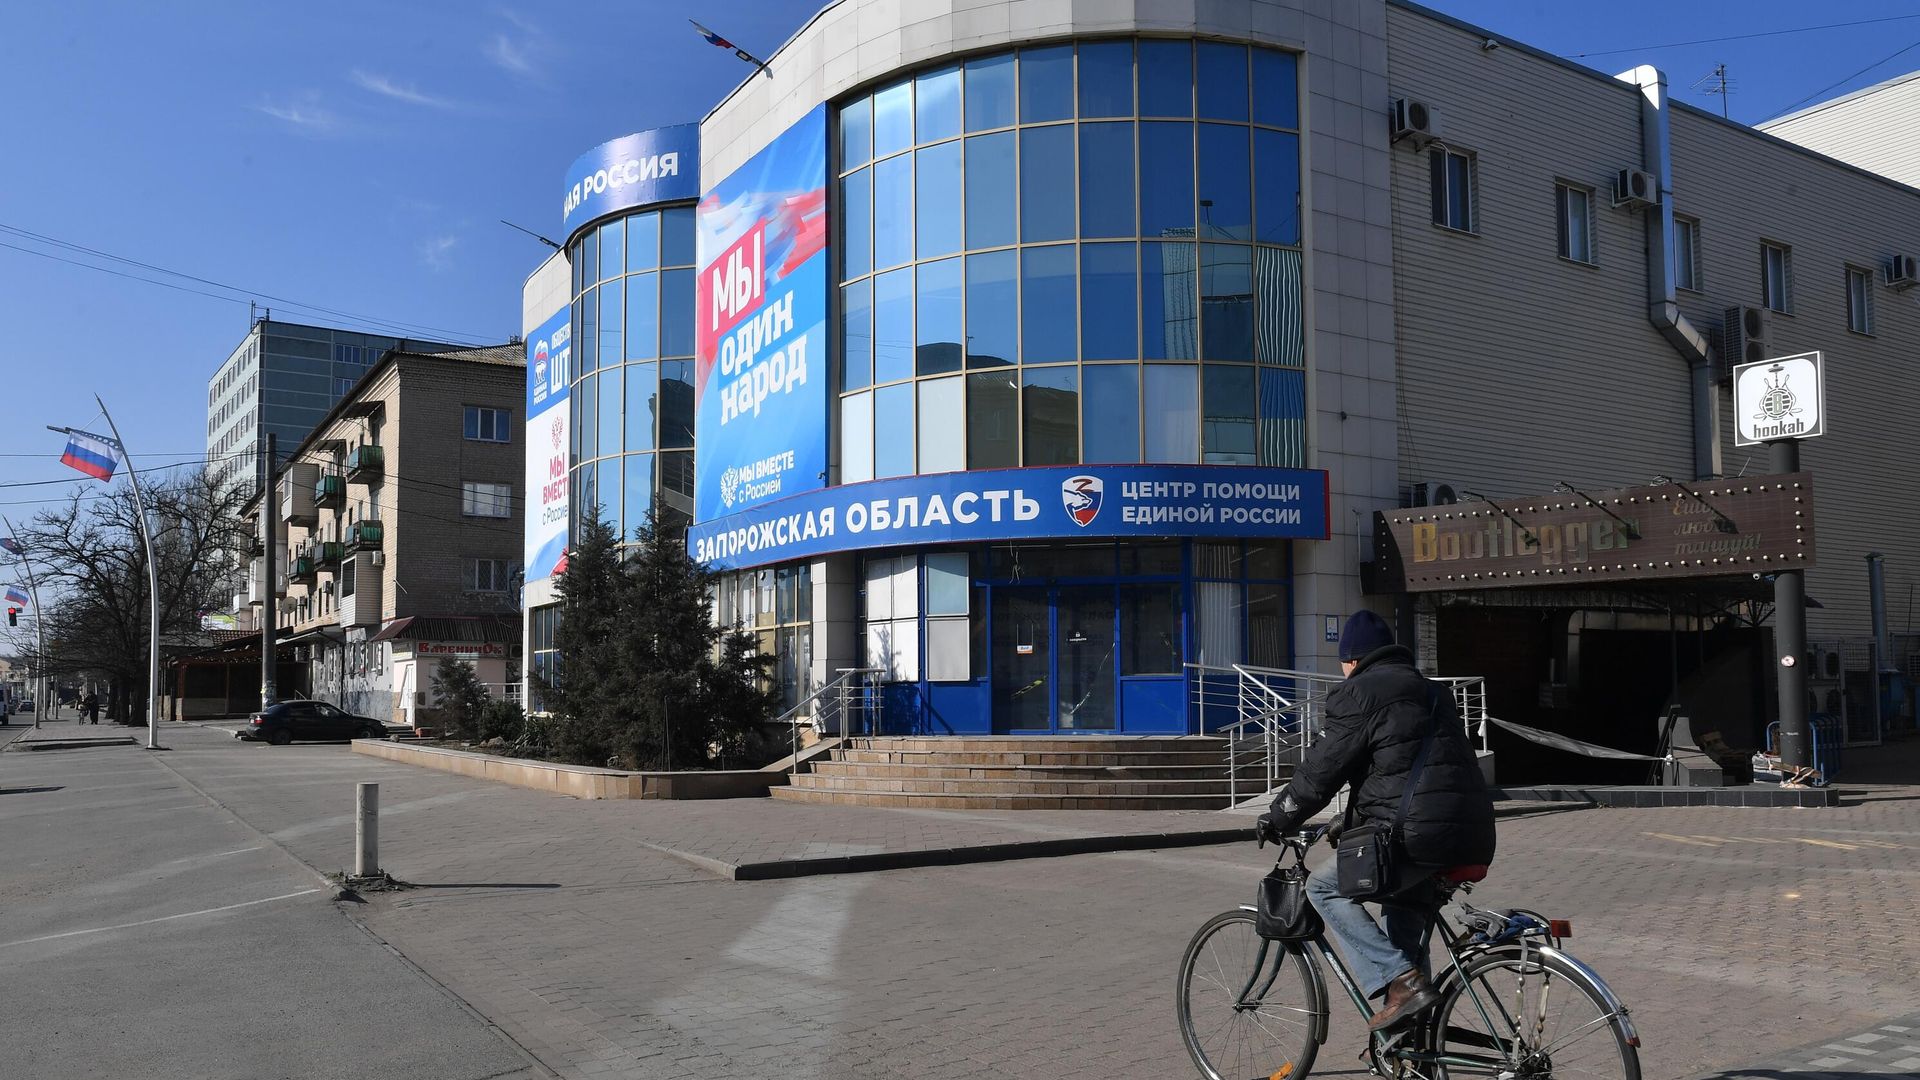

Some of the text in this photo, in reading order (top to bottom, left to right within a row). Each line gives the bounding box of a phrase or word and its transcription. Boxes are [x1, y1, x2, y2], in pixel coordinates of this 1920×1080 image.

[583, 152, 679, 200] РОССИЯ
[711, 229, 762, 332] МЫ
[720, 290, 794, 377] один
[550, 346, 571, 395] ШТ
[720, 335, 808, 426] народ
[1753, 418, 1804, 439] hookah
[549, 452, 565, 481] МЫ
[739, 449, 795, 484] МЫ ВМЕСТЕ
[738, 473, 781, 503] с Россией
[1121, 480, 1301, 503] ЦЕНТР ПОМОЩИ
[695, 489, 1041, 564] ЗАПОРОЖСКАЯ ОБЛАСТЬ
[1122, 502, 1302, 525] ЕДИНОЙ РОССИИ
